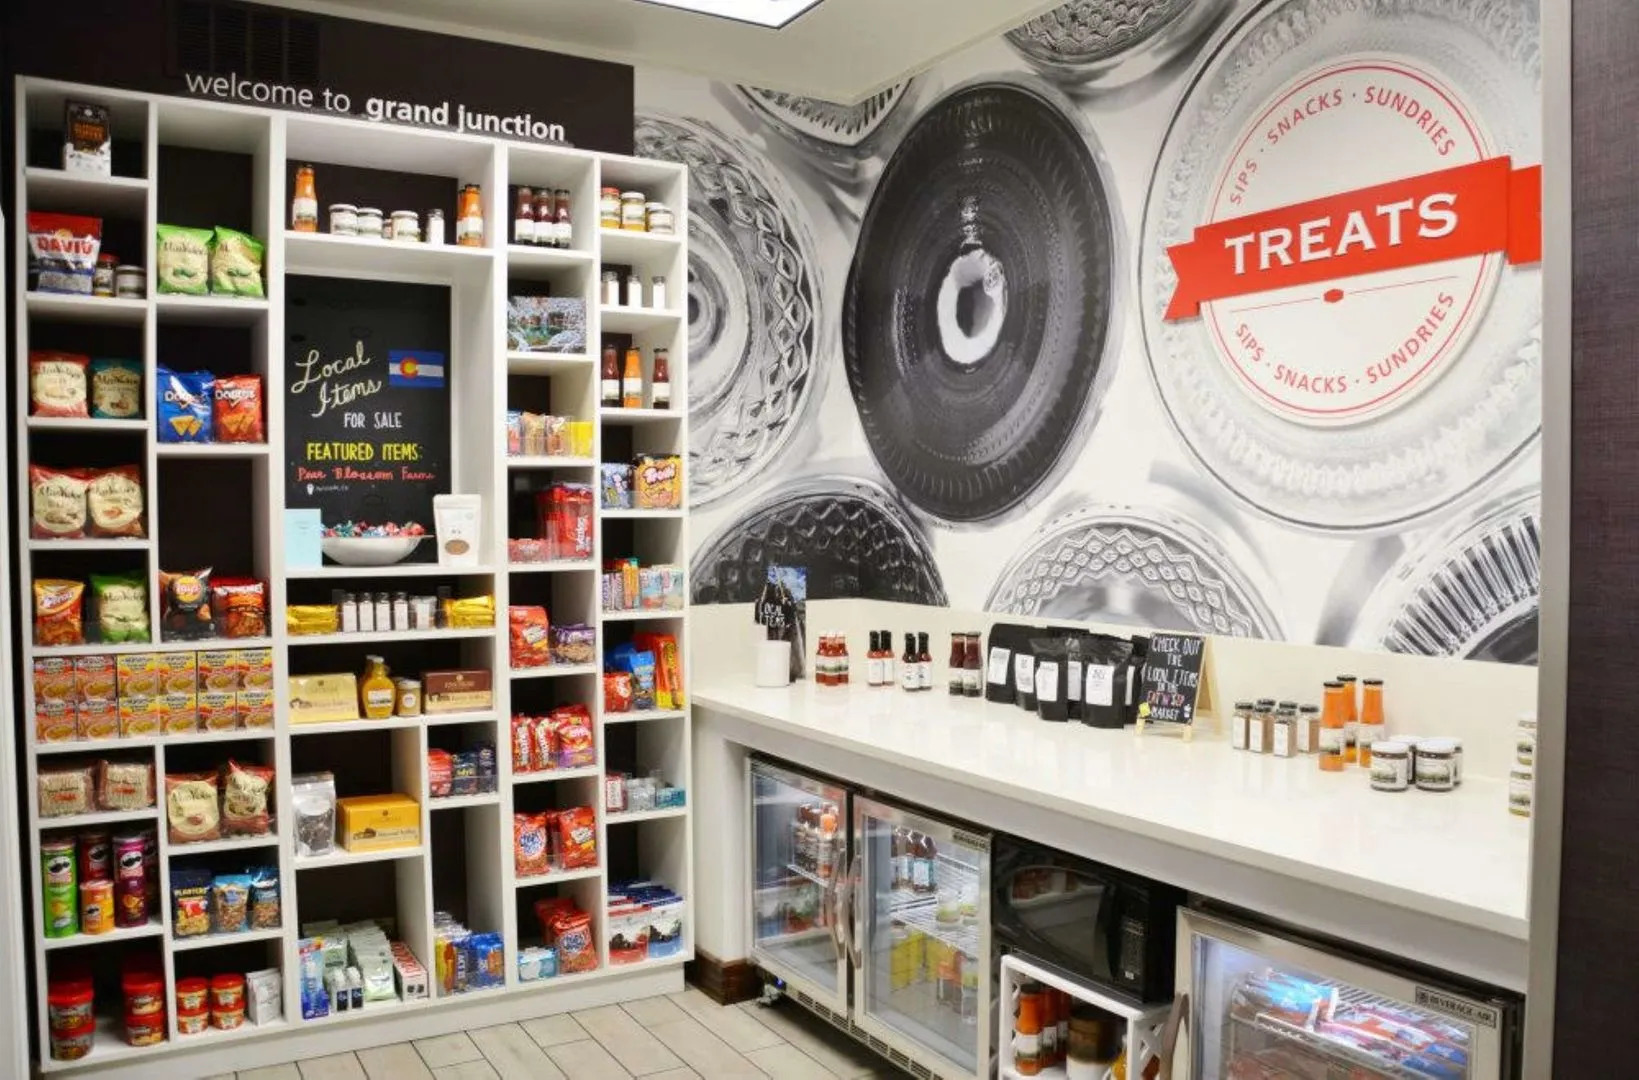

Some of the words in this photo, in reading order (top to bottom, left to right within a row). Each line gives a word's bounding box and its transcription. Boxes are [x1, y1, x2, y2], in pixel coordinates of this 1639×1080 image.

[185, 73, 313, 108] welcome
[322, 88, 351, 113] to
[365, 97, 449, 126] grand
[457, 104, 566, 142] junction
[1230, 158, 1258, 205] SIPS
[1267, 88, 1344, 145] SNACKS
[1364, 86, 1456, 157] SUNDRIES
[37, 236, 93, 255] DAVID
[1224, 193, 1459, 276] TREATS
[1235, 323, 1265, 362] SIPS
[1274, 363, 1348, 394] SNACKS
[1366, 291, 1455, 385] SUNDRIES
[291, 340, 371, 393] Local
[312, 379, 382, 417] Items
[344, 411, 366, 429] FOR
[374, 411, 403, 430] SALE
[306, 441, 374, 461] FEATURED
[1151, 636, 1180, 653] CHECK
[174, 887, 208, 897] PLANTERS
